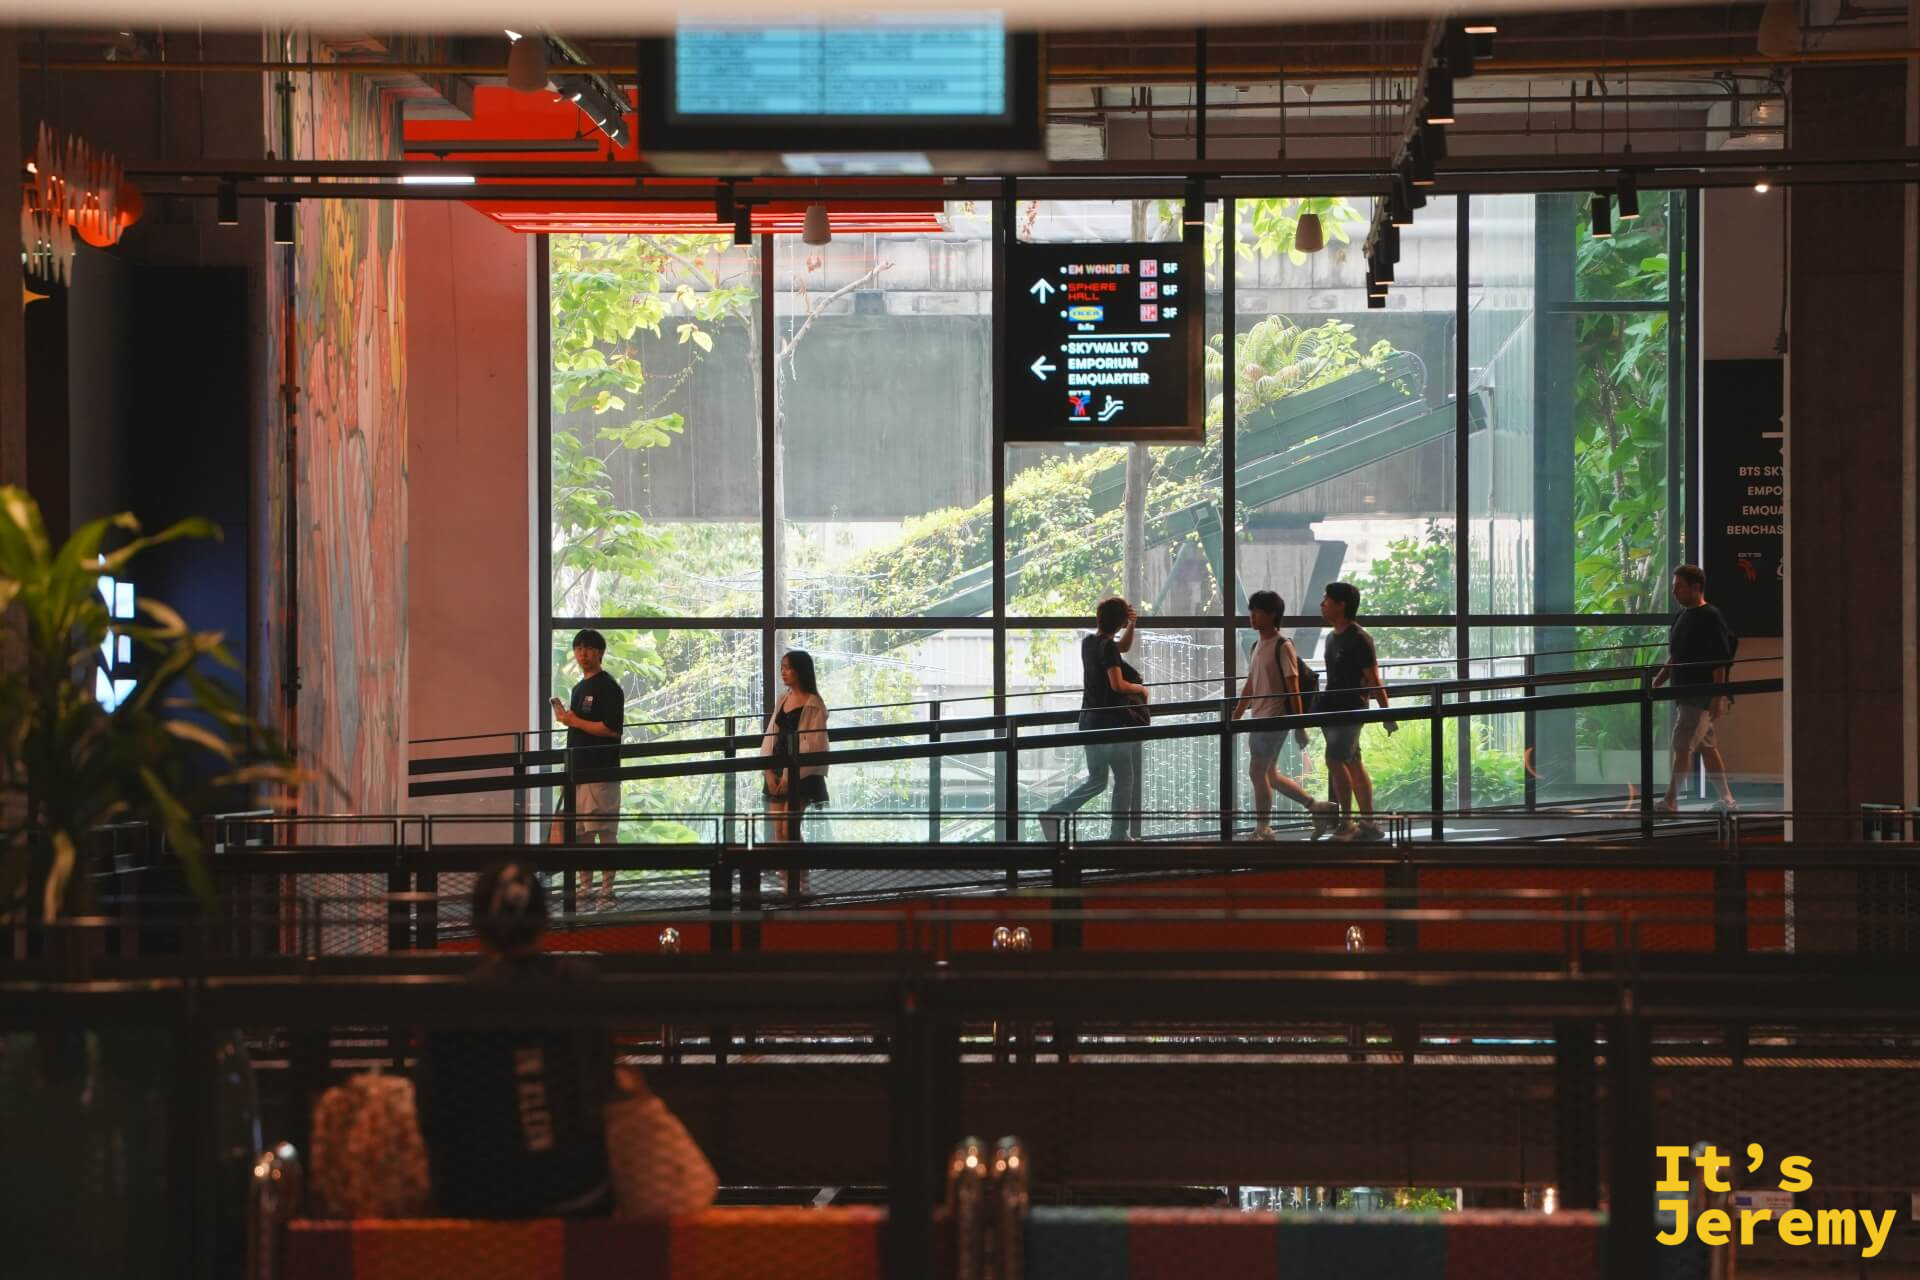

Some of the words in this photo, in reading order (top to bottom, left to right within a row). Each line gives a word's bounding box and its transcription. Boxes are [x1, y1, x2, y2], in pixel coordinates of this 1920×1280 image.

[1068, 264, 1084, 275] EM
[1085, 264, 1130, 274] WONDER
[1068, 282, 1117, 292] SPHERE
[1068, 292, 1100, 302] HALL
[1068, 342, 1129, 354] SKYWALK
[1131, 341, 1149, 354] TO
[1068, 357, 1139, 370] EMPORIUM
[1068, 372, 1150, 386] EMQUARTIER
[1739, 466, 1761, 477] BTS
[1727, 525, 1784, 535] BENCHAS
